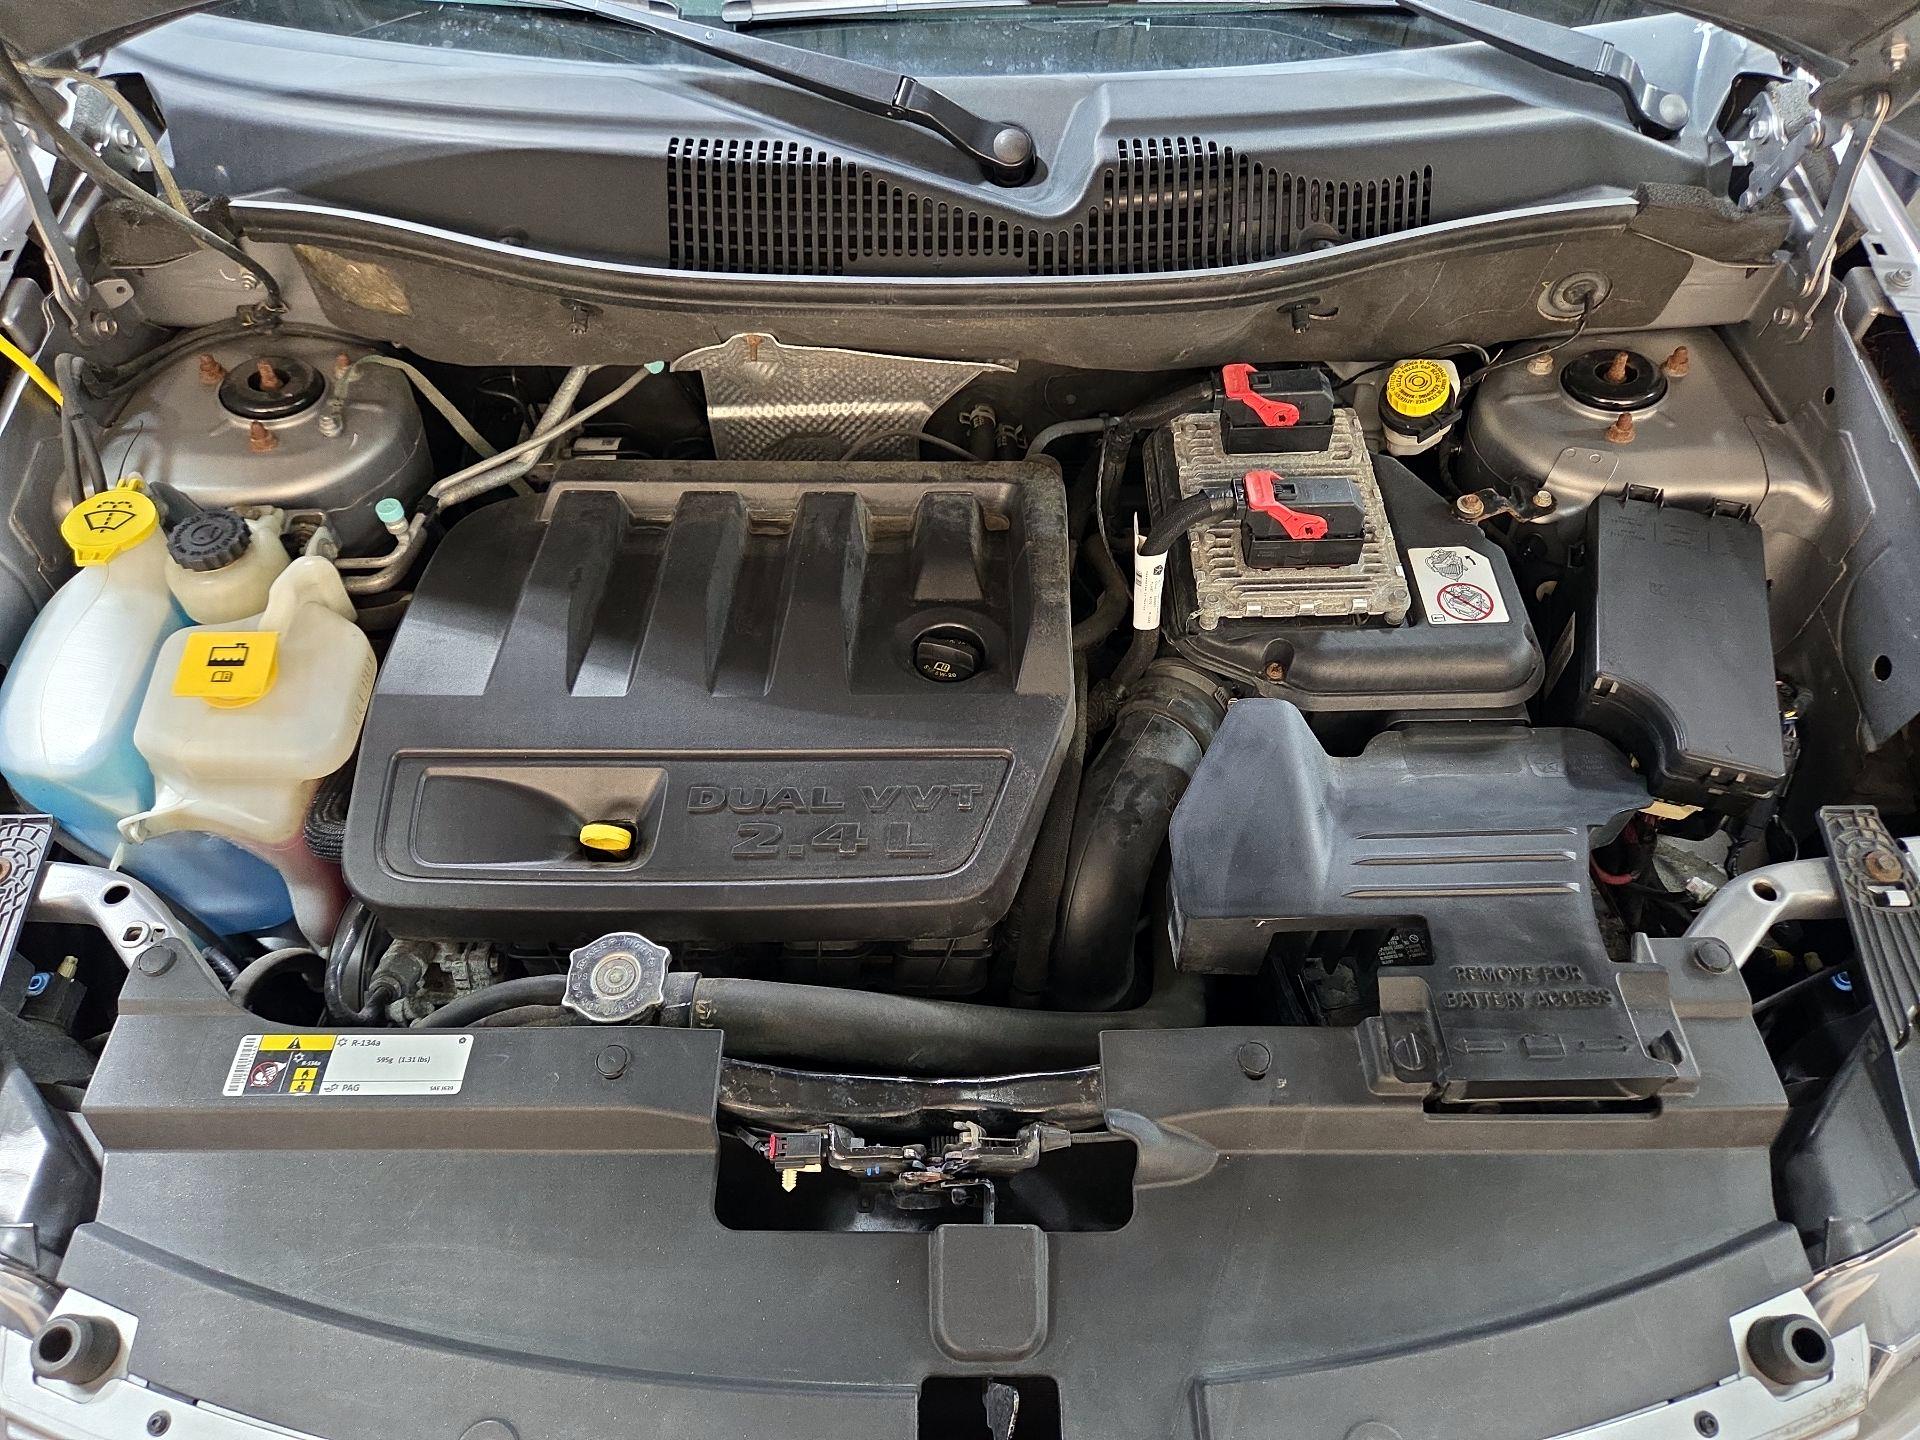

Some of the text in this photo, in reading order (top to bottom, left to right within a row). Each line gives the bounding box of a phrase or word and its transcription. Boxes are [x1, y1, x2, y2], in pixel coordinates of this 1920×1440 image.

[687, 784, 983, 813] DUAL VVT
[1454, 964, 1585, 984] REMOVE FOR
[1442, 989, 1615, 1009] BATTERY ACCESS
[351, 1039, 381, 1047] R-134a
[376, 1056, 431, 1064] 595g (1.31 lbs)
[341, 1083, 360, 1092] PAG
